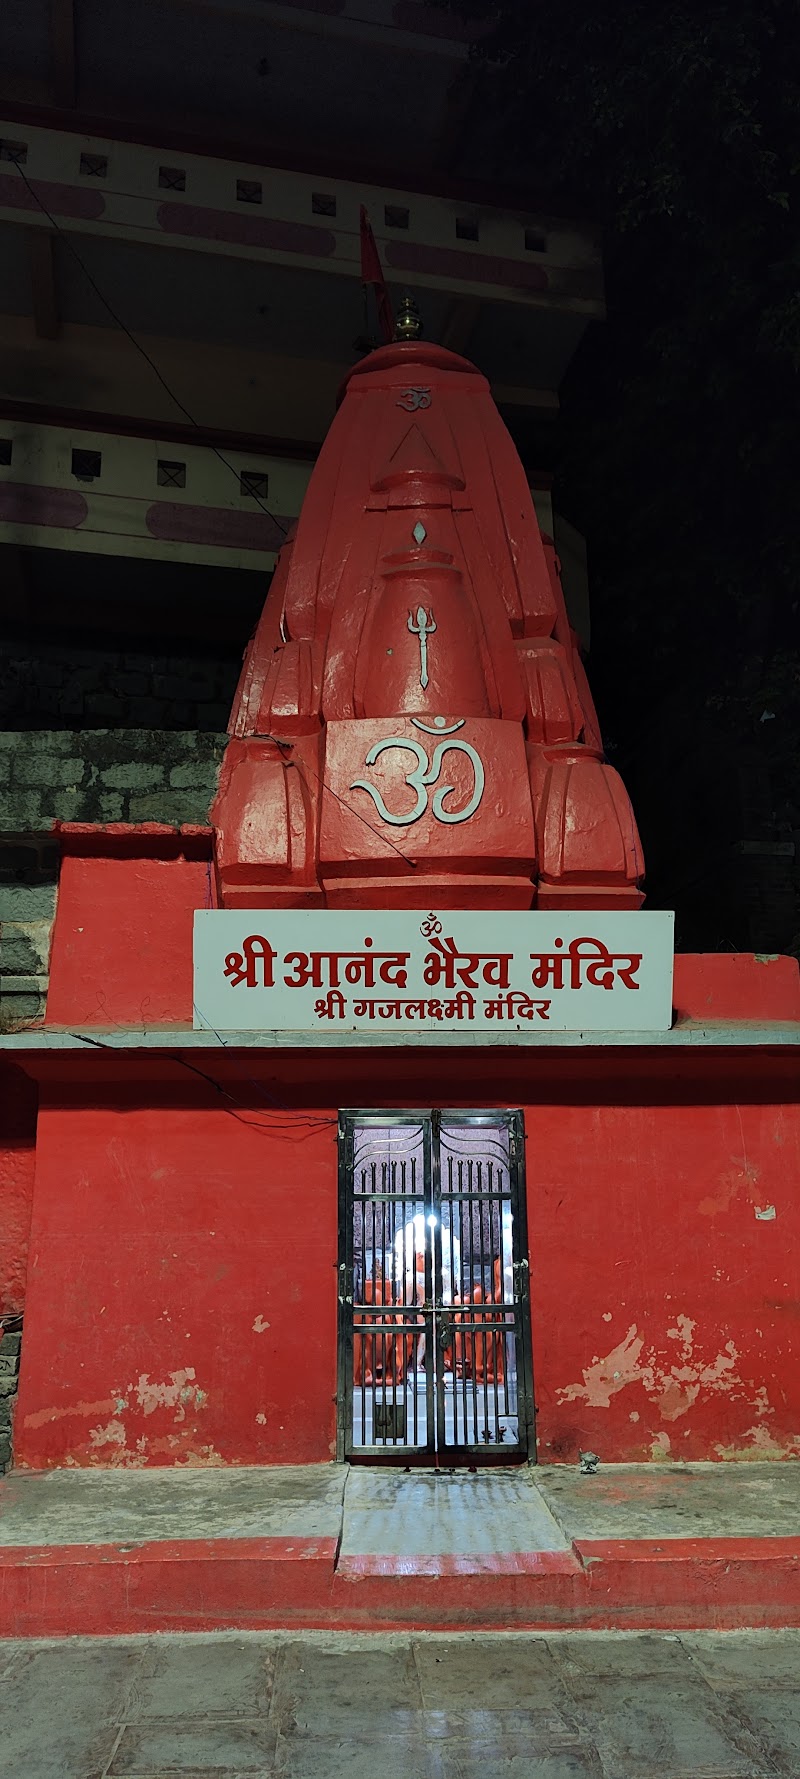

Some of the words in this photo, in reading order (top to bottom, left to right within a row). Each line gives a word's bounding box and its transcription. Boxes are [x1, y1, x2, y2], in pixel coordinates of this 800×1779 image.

[420, 912, 442, 937] ॐ
[223, 935, 277, 988] श्री
[284, 936, 410, 989] आनंद
[424, 936, 513, 989] भैरव
[530, 936, 643, 990] मंदिर
[315, 989, 347, 1020] श्री
[354, 990, 476, 1020] गजलक्ष्मी
[483, 991, 551, 1020] मंदिर
